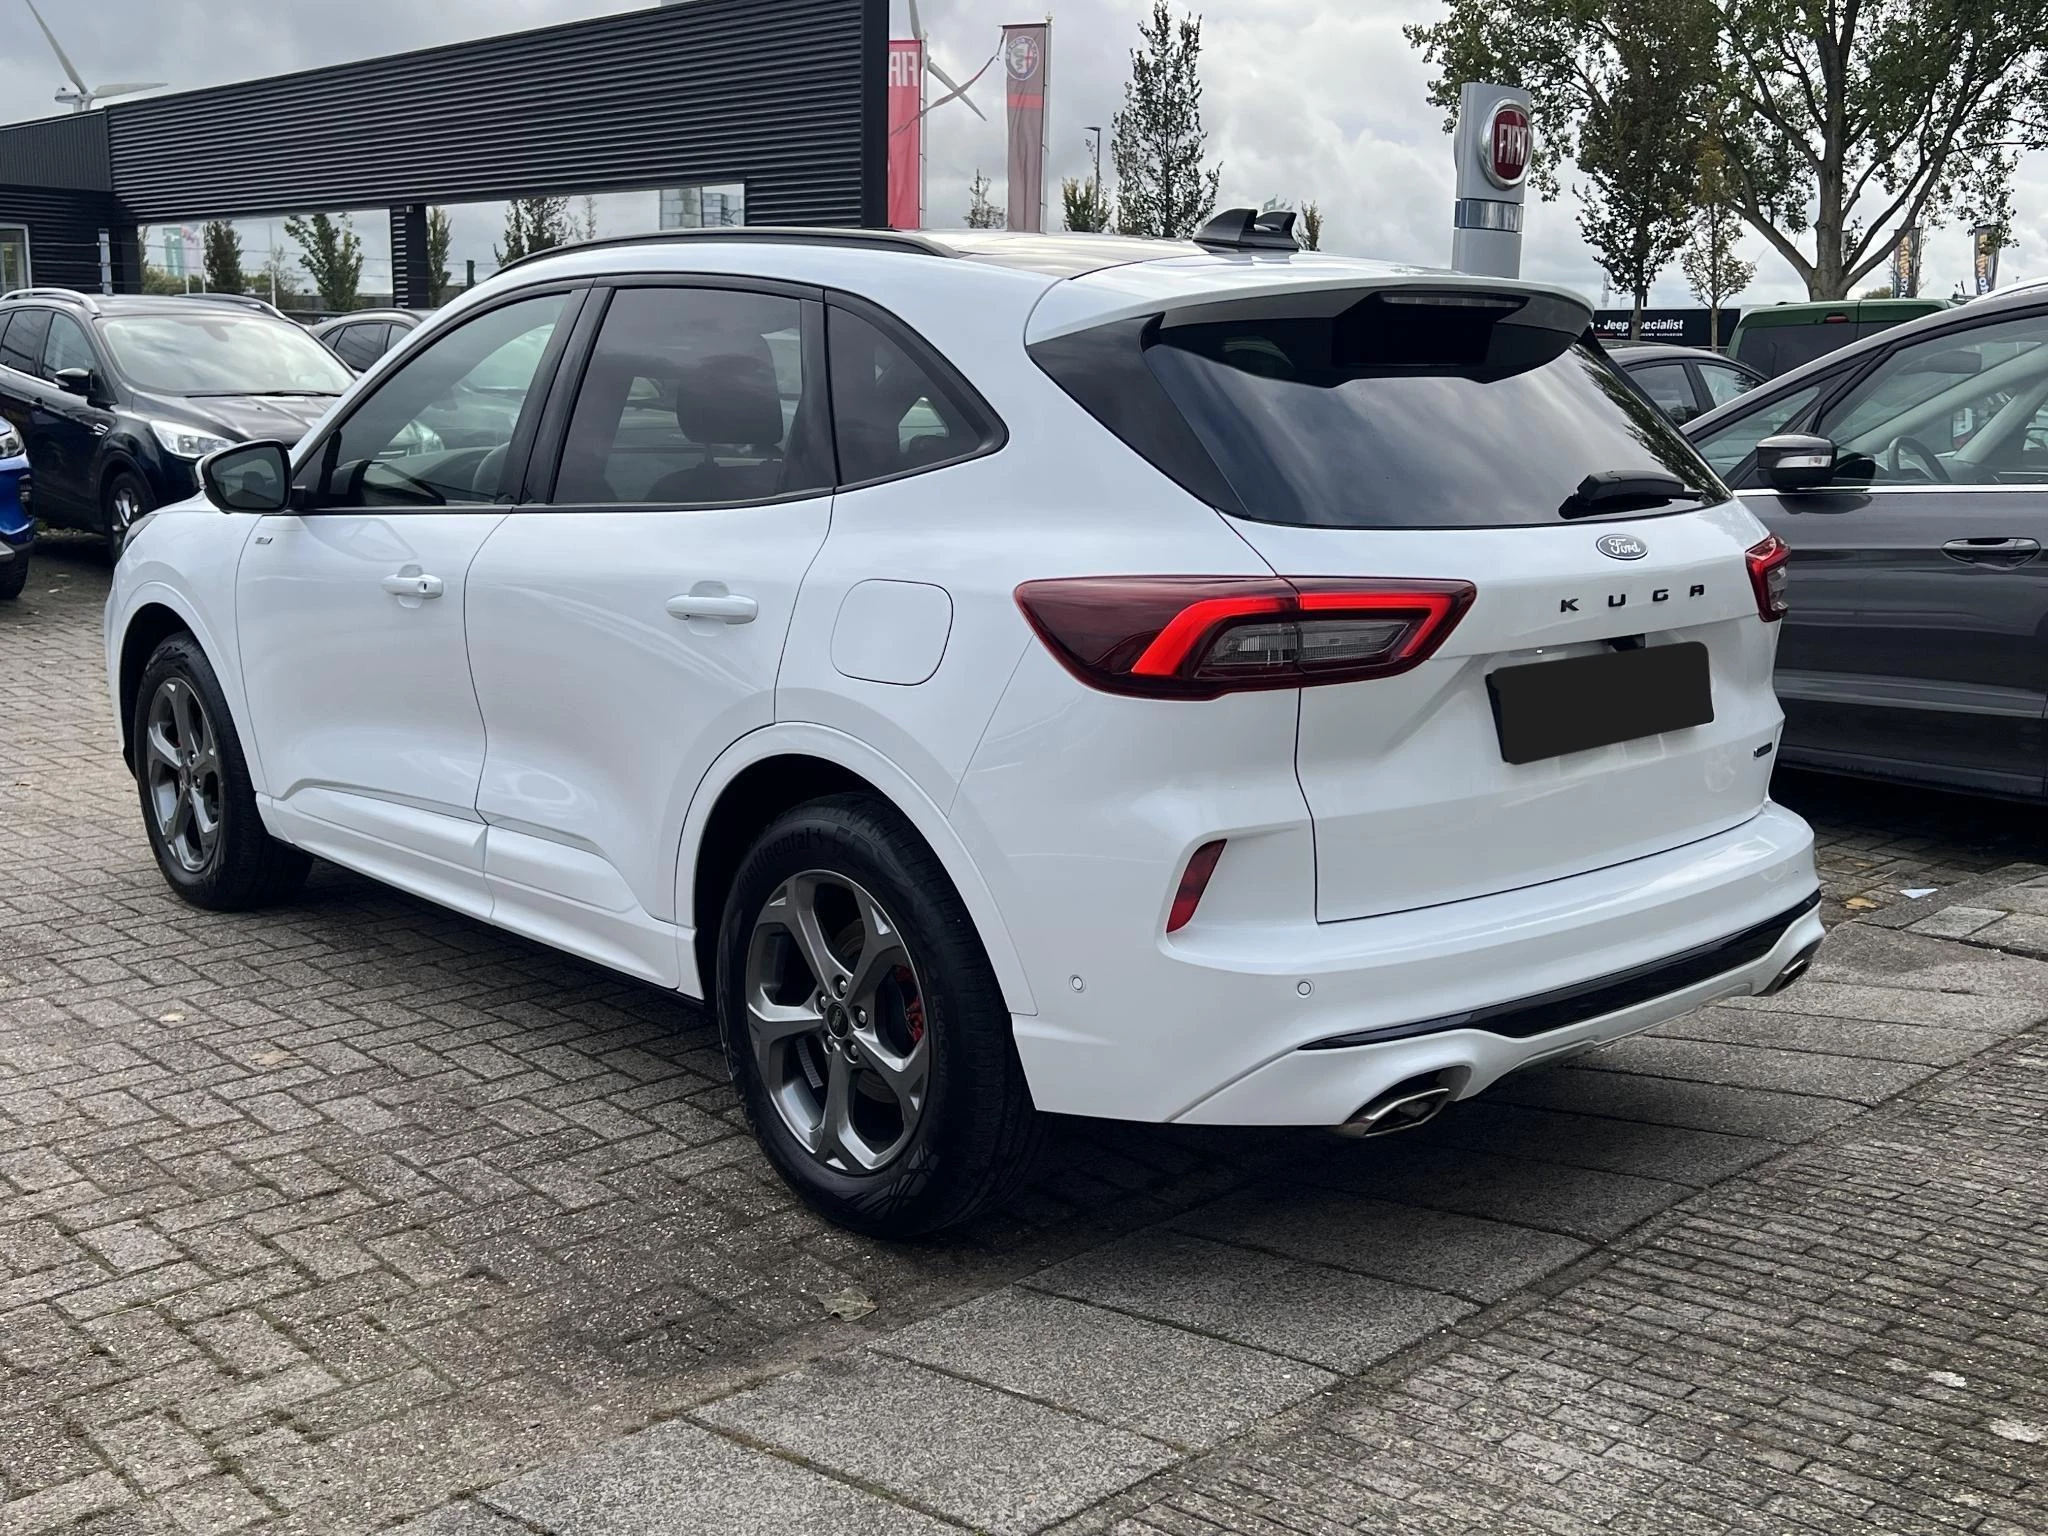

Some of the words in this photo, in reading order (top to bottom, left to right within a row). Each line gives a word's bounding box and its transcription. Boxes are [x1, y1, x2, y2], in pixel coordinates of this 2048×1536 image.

[1498, 123, 1527, 166] FIAT
[1603, 319, 1629, 332] Jeep
[1640, 319, 1684, 330] ecialist
[1608, 538, 1641, 554] Ford
[1560, 584, 1704, 612] KUGA
